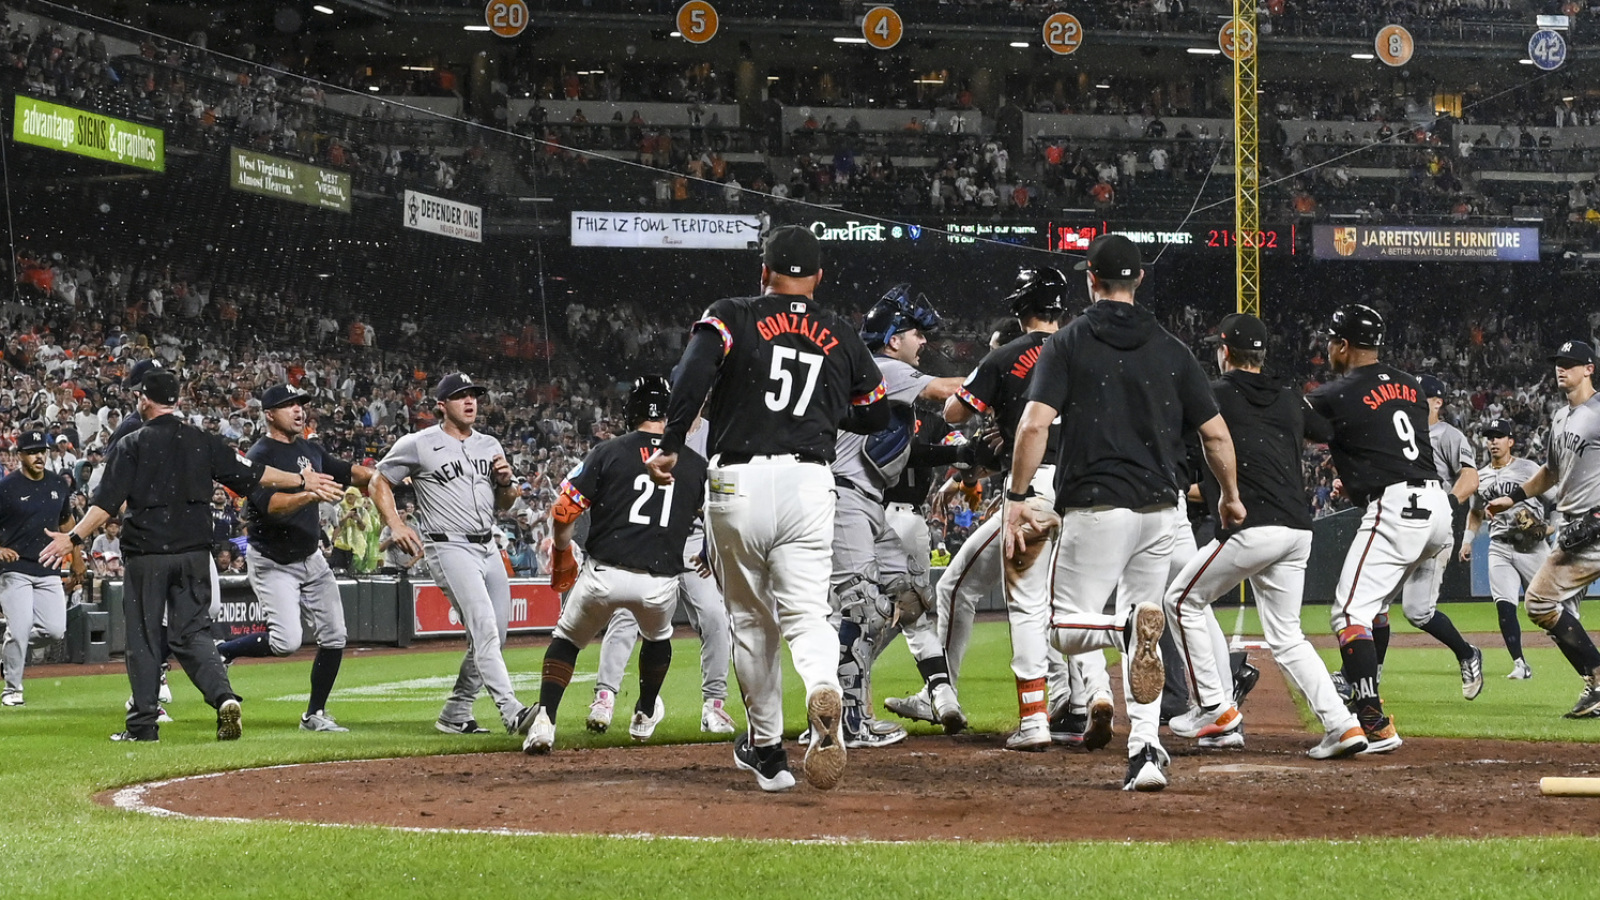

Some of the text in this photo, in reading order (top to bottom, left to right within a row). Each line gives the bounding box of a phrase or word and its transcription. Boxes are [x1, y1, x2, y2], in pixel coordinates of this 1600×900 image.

[493, 3, 523, 27] 20
[691, 10, 705, 33] 5
[874, 16, 889, 40] 4
[1050, 22, 1077, 45] 22
[1388, 34, 1402, 57] 8
[1534, 36, 1561, 61] 42
[23, 104, 156, 163] advantage SIGNS & graphics
[238, 154, 256, 171] West
[257, 159, 286, 178] Virginia
[319, 170, 339, 185] WEST
[238, 171, 263, 189] Almost
[421, 198, 479, 229] DEFENDER ONE
[576, 216, 744, 234] THIZ IZ FOWL TERITOREE
[960, 225, 976, 233] not
[976, 223, 993, 235] just
[994, 226, 1010, 234] our
[1111, 231, 1155, 243] NING
[1156, 231, 1193, 244] TICKET:
[1361, 230, 1521, 248] JARRETTSVILLE FURNITURE
[1388, 248, 1412, 256] BETTER
[1413, 248, 1432, 256] WAY
[1433, 248, 1443, 256] TO
[1444, 248, 1459, 256] BUY
[1460, 248, 1498, 257] FURNITURE
[756, 311, 840, 356] GONZÁLEZ
[764, 344, 825, 418] 57
[1362, 383, 1417, 410] SANDERS
[1392, 409, 1420, 461] 9
[1563, 431, 1590, 458] YORK
[431, 459, 464, 486] NEW
[628, 473, 675, 527] 21
[217, 602, 247, 622] ENDER
[509, 598, 527, 621] rm
